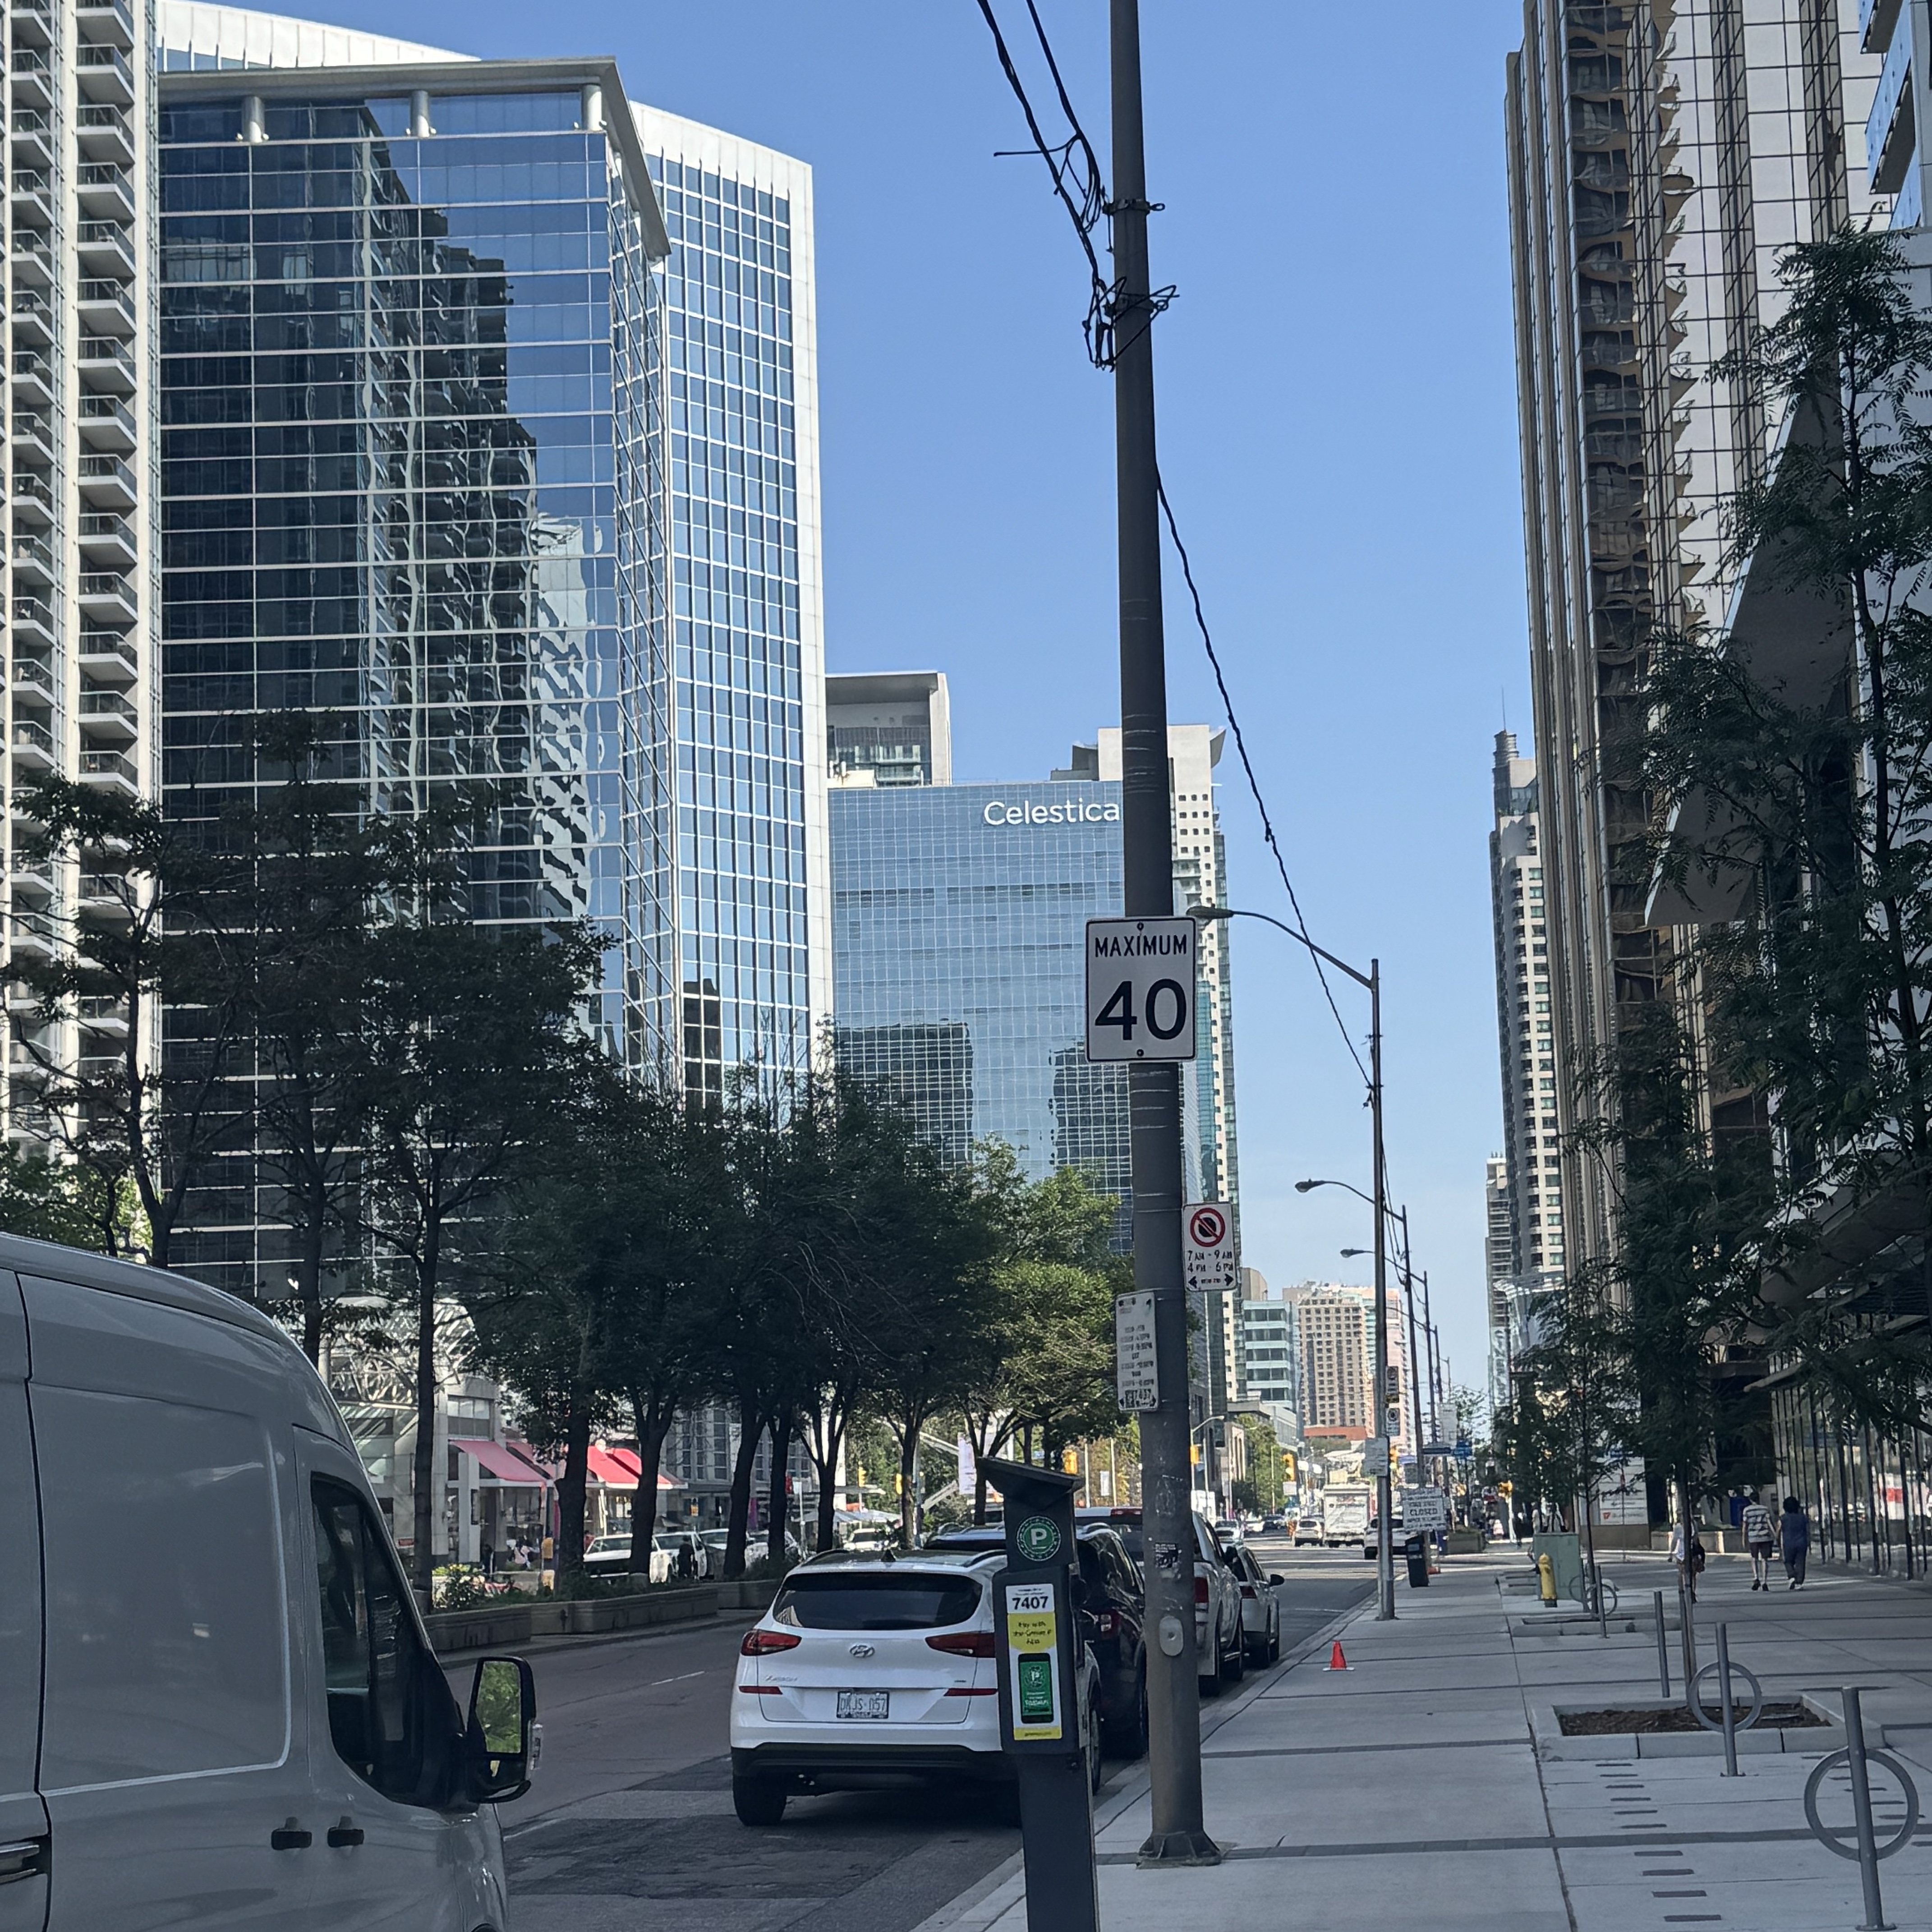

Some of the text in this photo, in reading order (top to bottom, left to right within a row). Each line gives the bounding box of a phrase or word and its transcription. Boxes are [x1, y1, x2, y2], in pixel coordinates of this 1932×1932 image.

[984, 797, 1120, 825] Celestica
[1095, 934, 1187, 957] MAXIMUM
[1095, 978, 1187, 1040] 40
[1187, 1250, 1193, 1261] 7
[1194, 1252, 1205, 1260] AM
[1214, 1250, 1220, 1259] 9
[1222, 1251, 1233, 1259] AM
[1187, 1262, 1193, 1273] 4
[1196, 1264, 1206, 1272] PM
[1216, 1261, 1221, 1272] 6
[1223, 1263, 1233, 1271] PM
[1031, 1528, 1047, 1546] P
[1012, 1596, 1049, 1610] 7407
